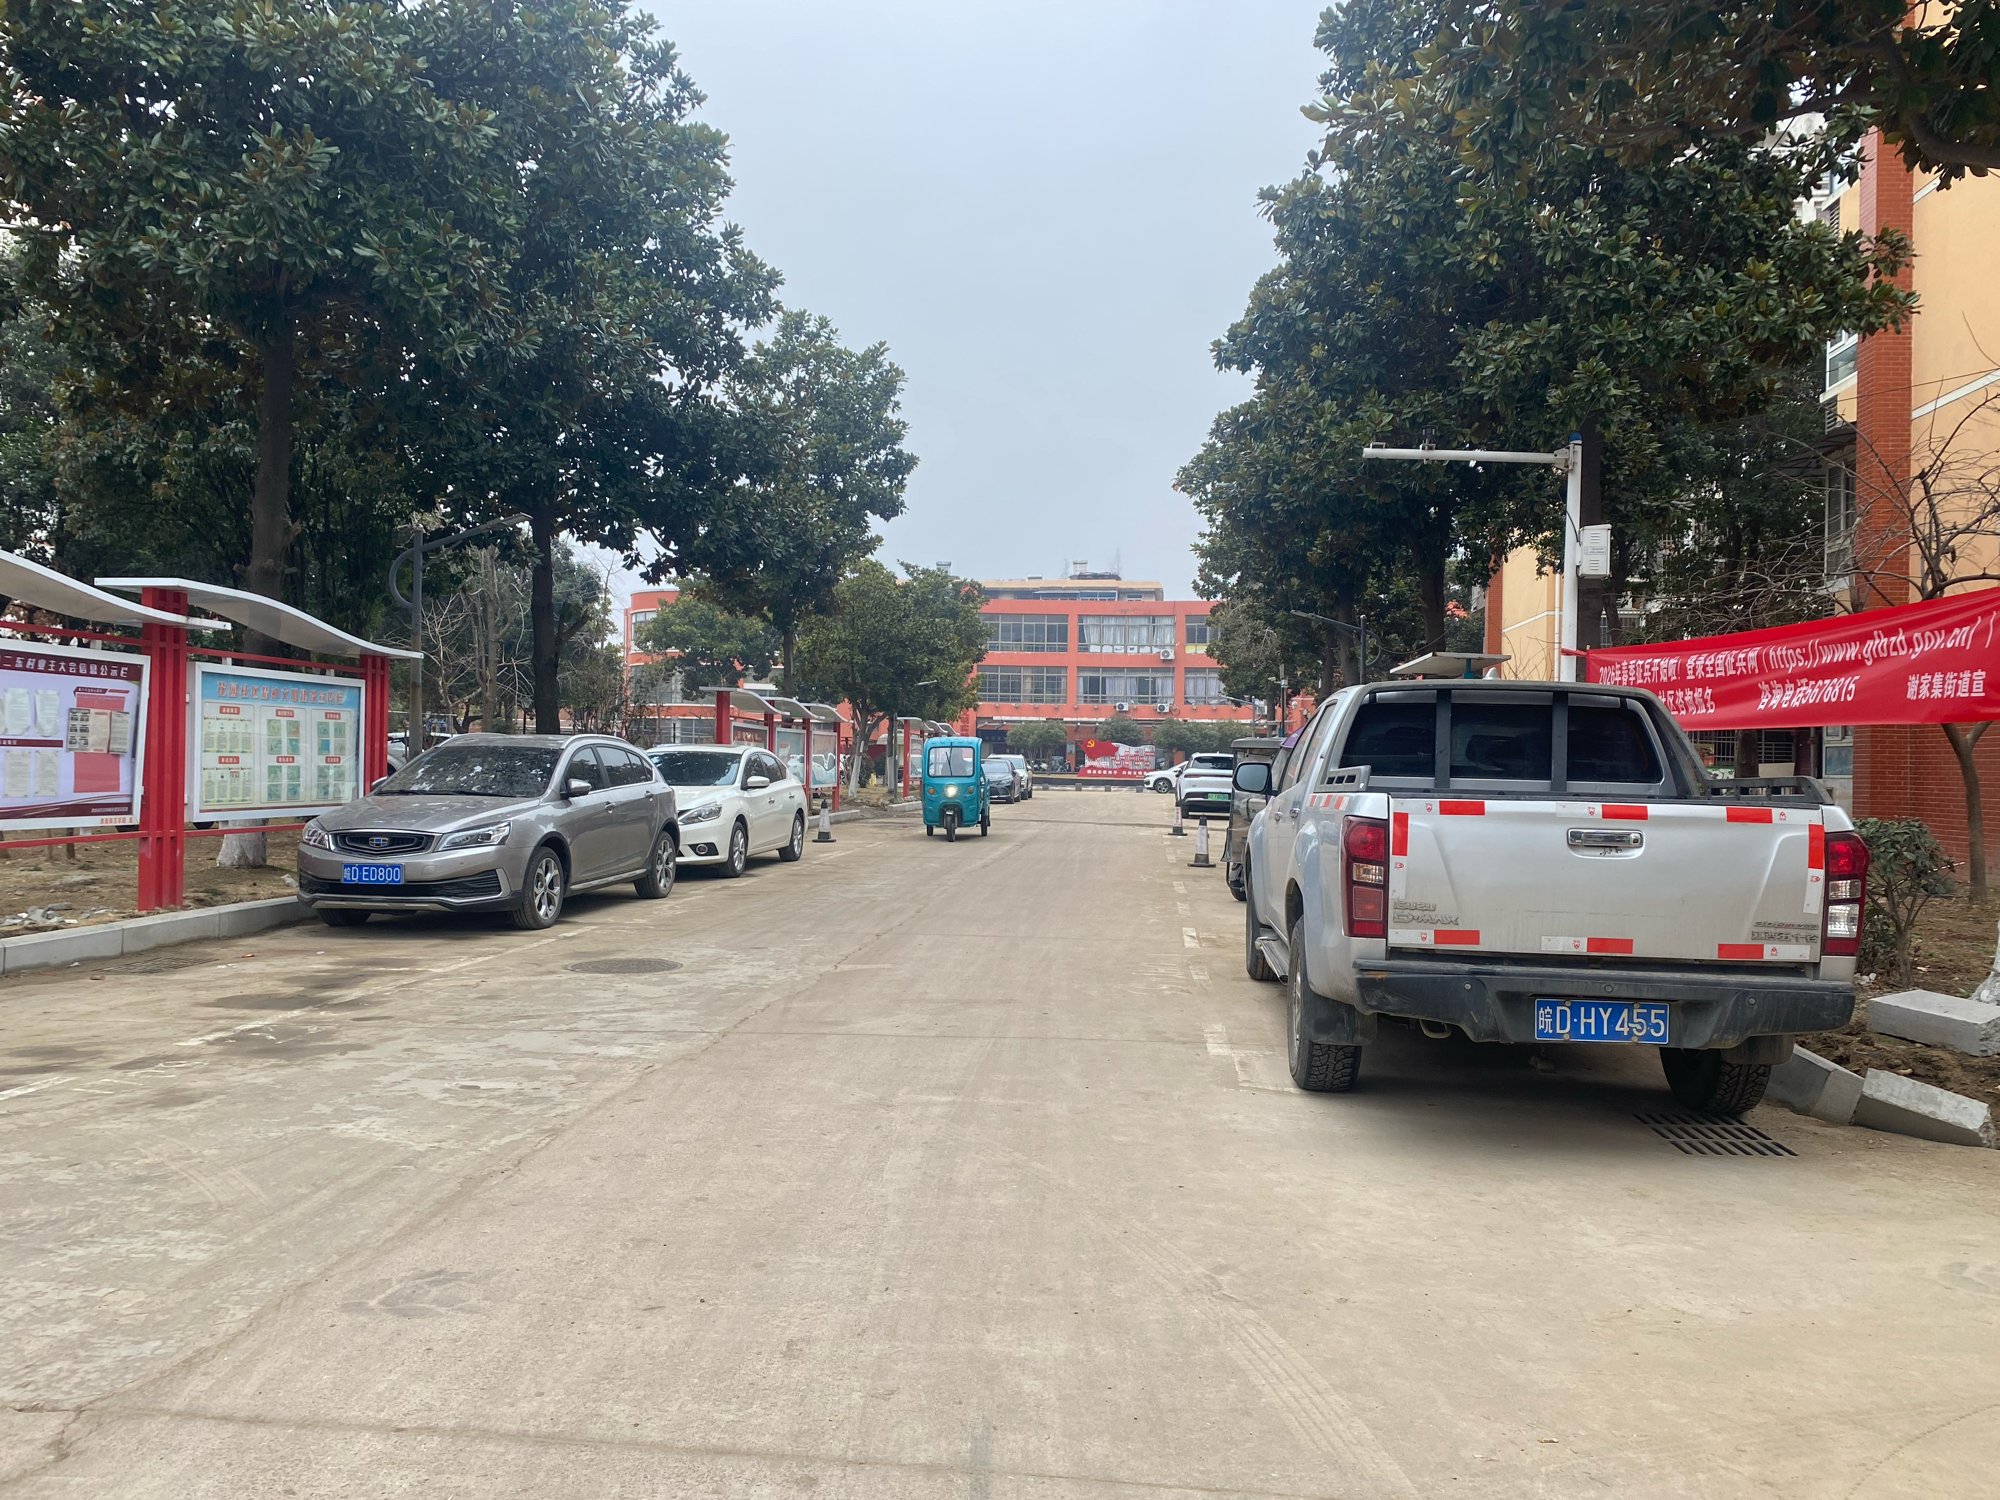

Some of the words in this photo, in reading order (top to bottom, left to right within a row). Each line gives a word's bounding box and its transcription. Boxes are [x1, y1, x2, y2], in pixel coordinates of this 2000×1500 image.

[0, 655, 128, 678] 二东村业主大会信息公示栏
[1906, 669, 1986, 700] 谢家集街道宣
[1752, 930, 1819, 944] 江西五十铃
[1539, 1005, 1666, 1037] 皖D·HY455
